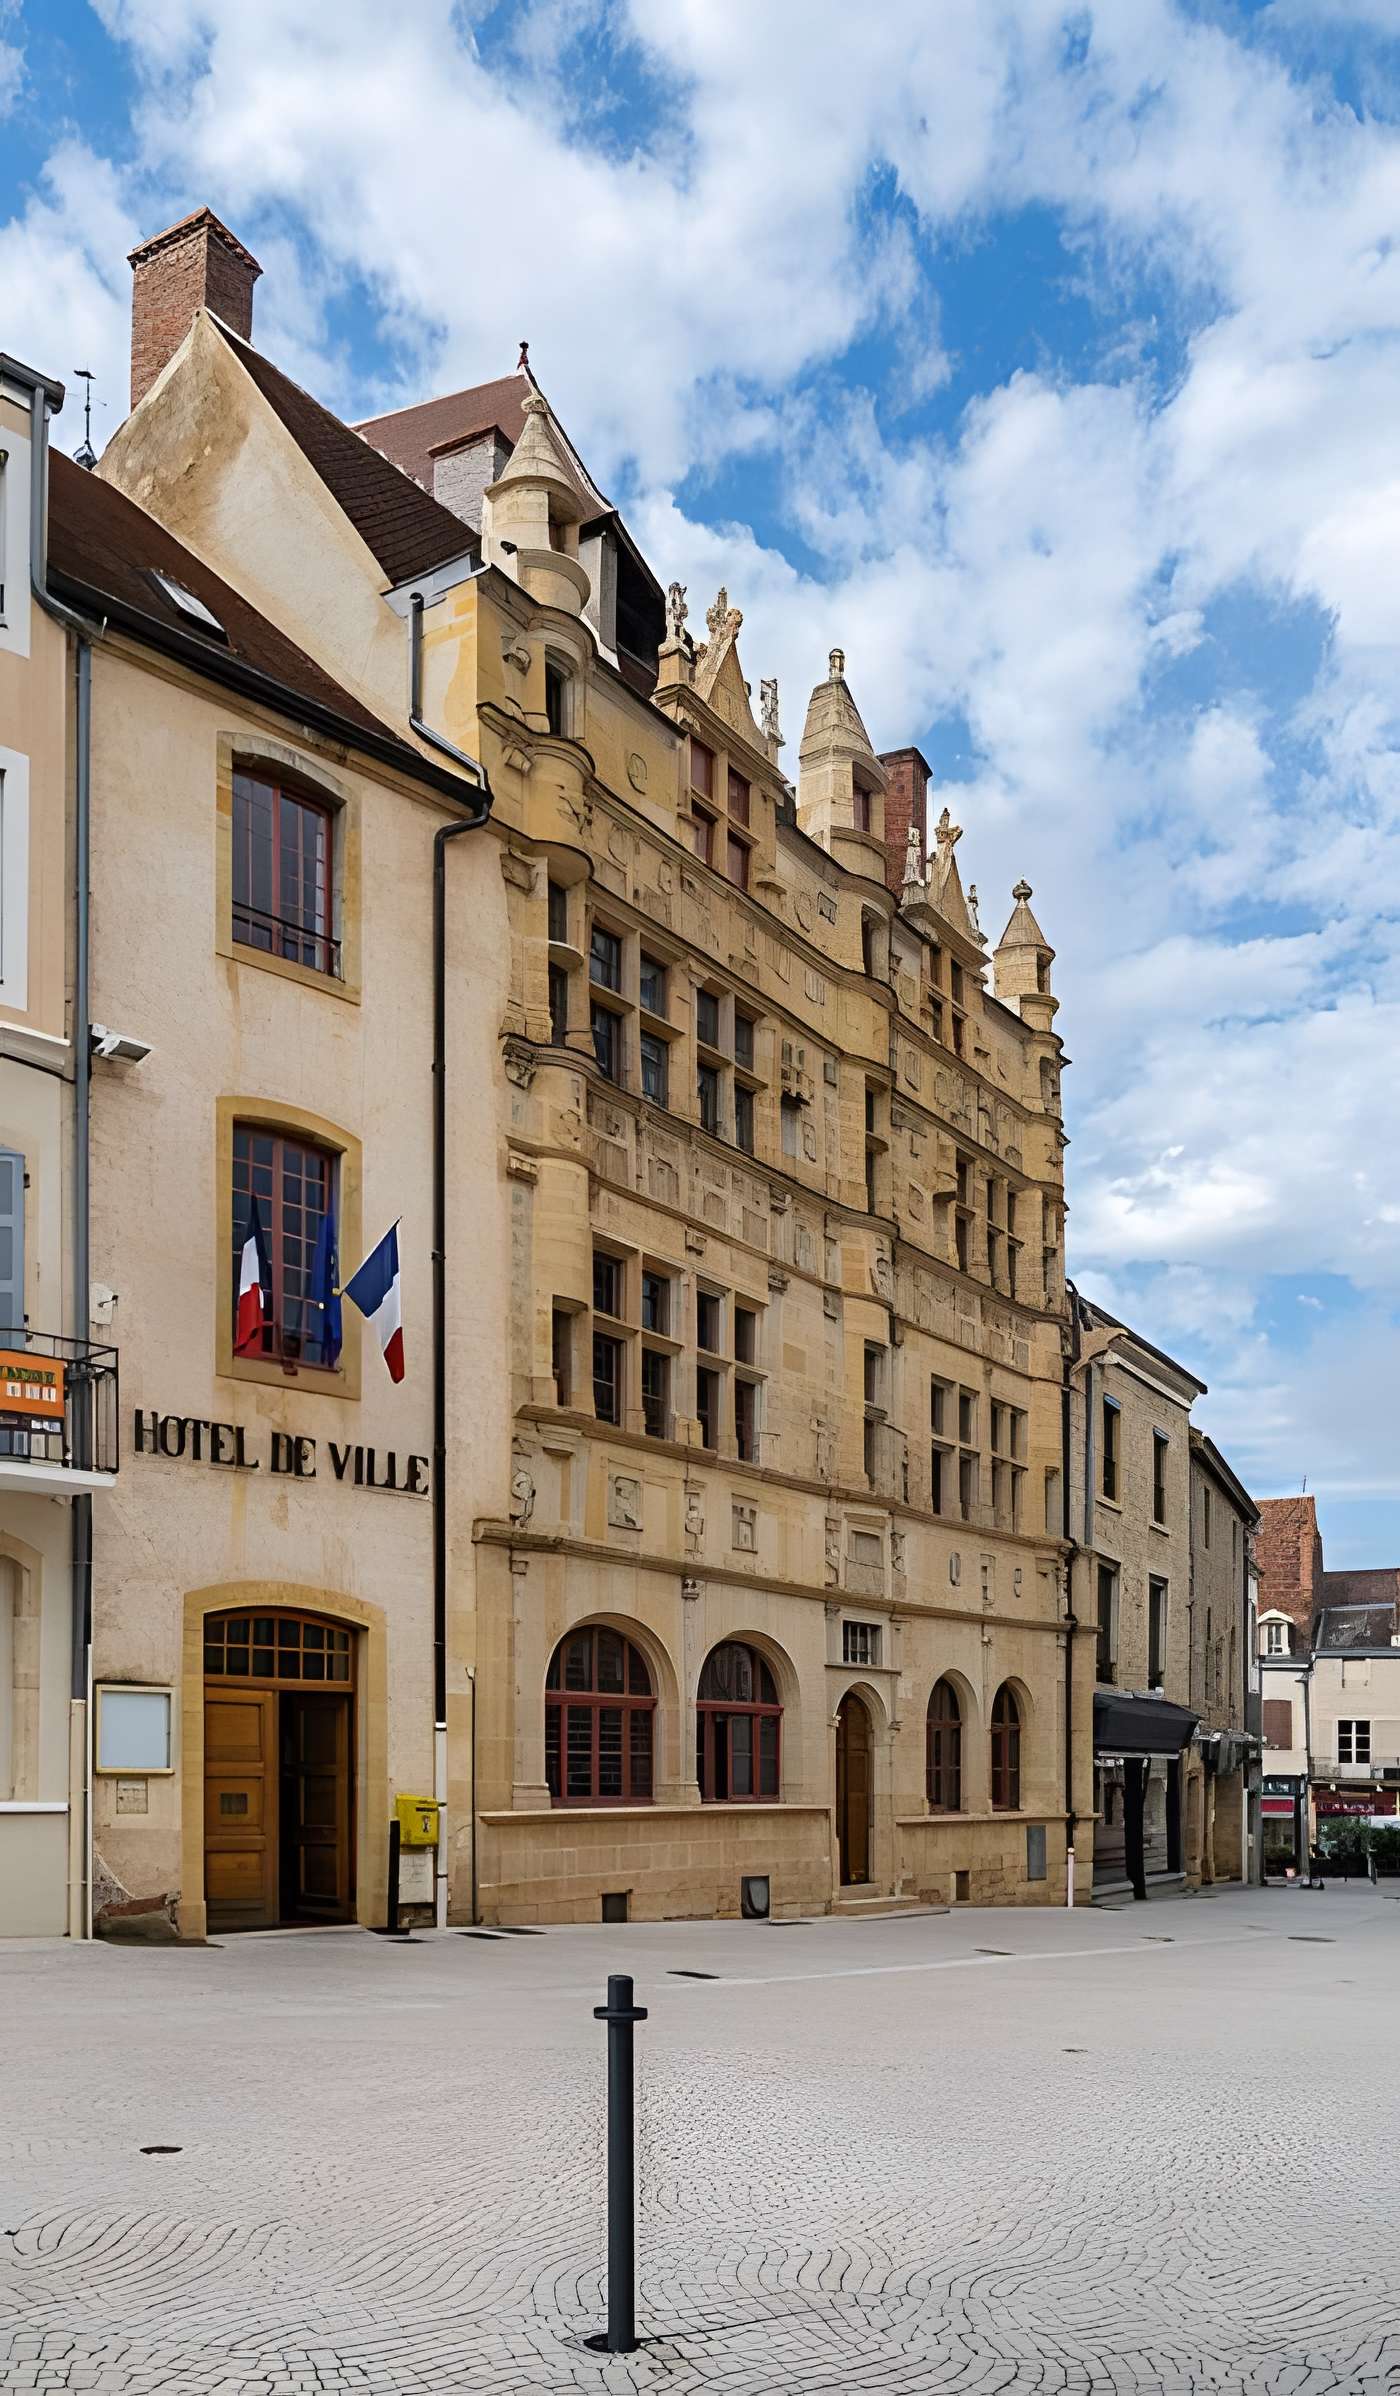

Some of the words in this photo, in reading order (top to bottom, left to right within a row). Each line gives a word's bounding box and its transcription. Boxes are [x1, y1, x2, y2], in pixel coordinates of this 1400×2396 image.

[134, 1408, 260, 1469] HOTEL
[271, 1431, 317, 1478] DE
[328, 1441, 430, 1496] VILLE
